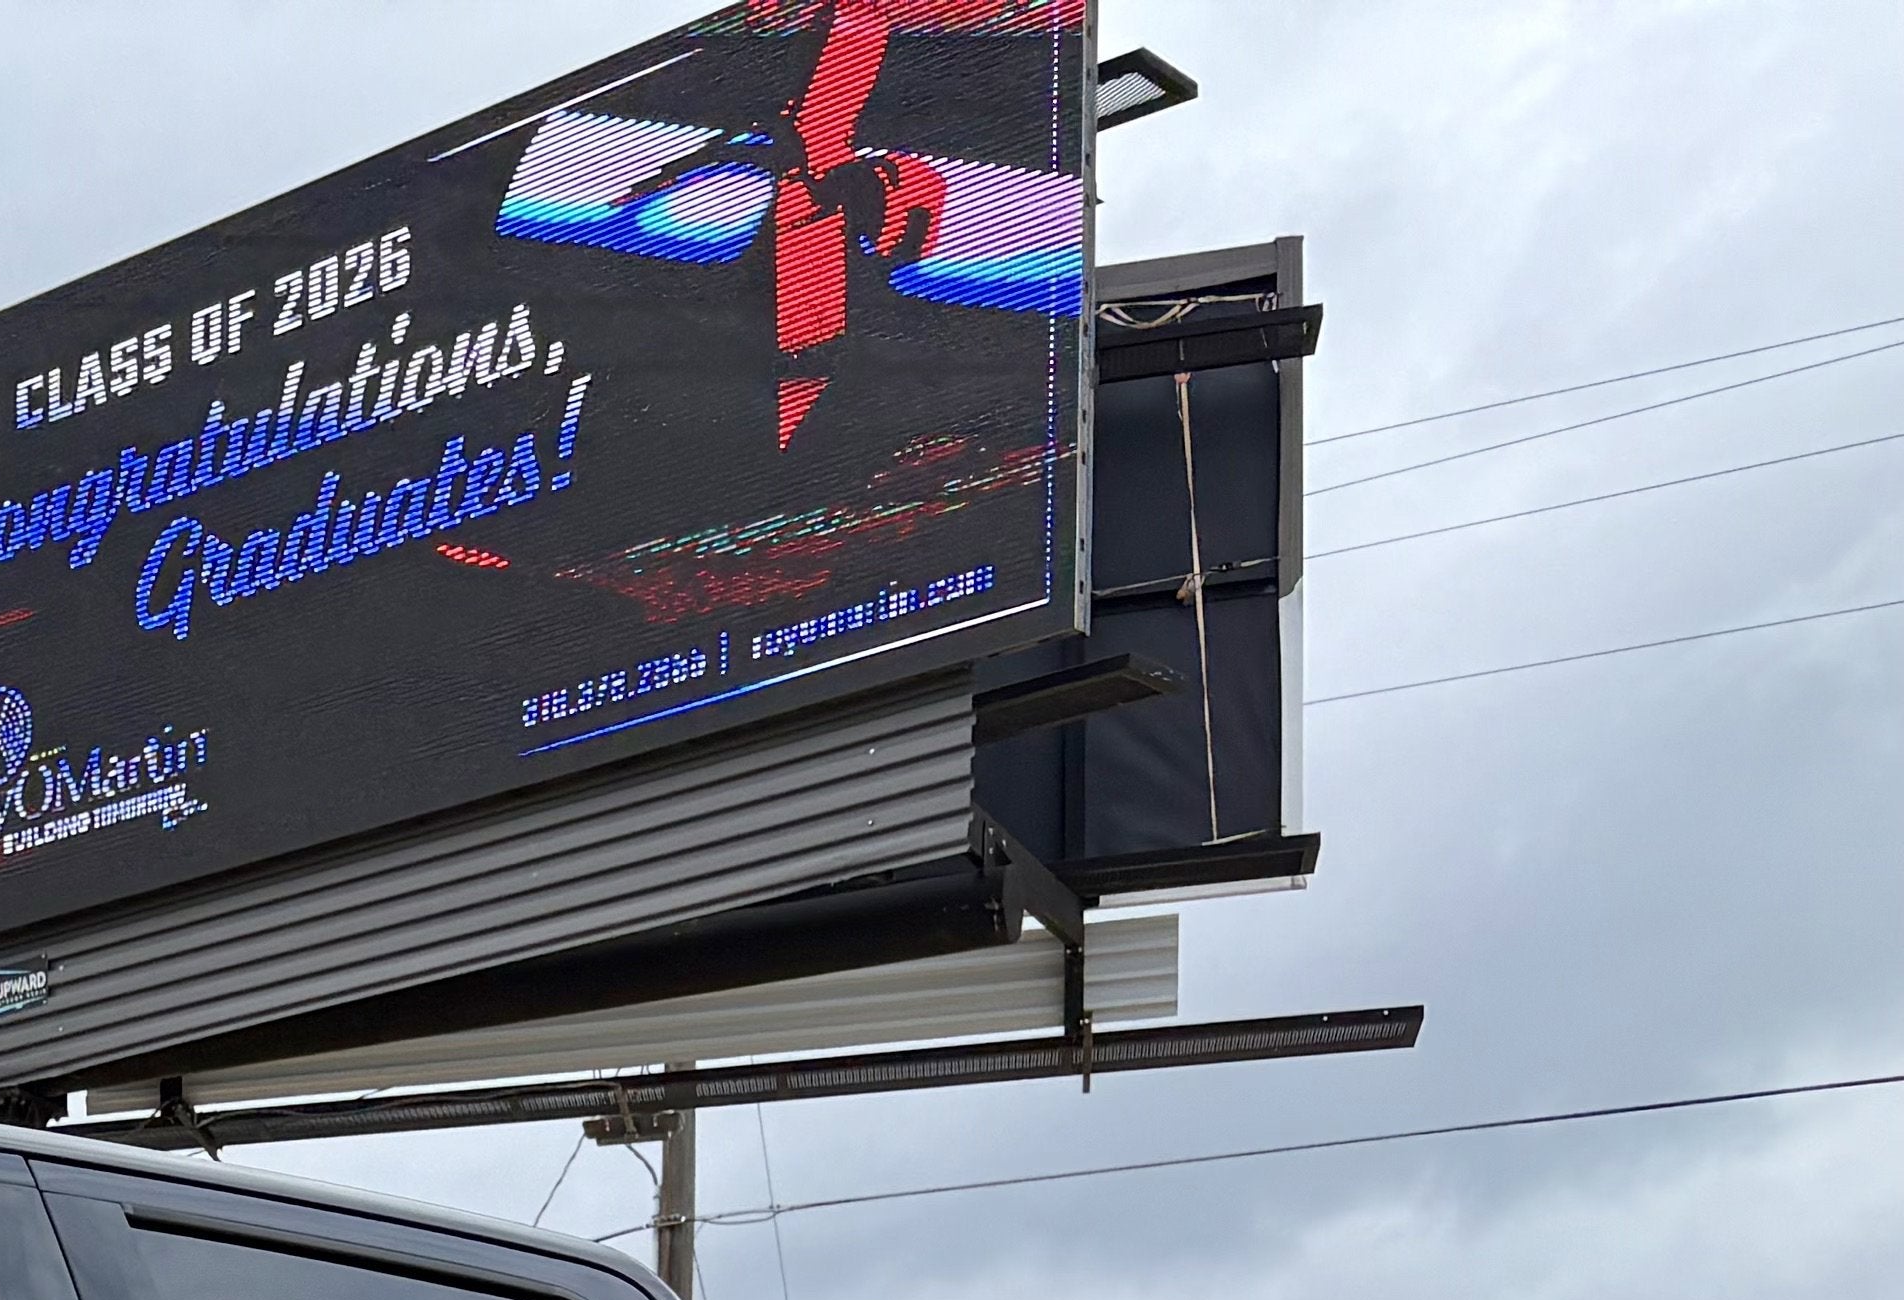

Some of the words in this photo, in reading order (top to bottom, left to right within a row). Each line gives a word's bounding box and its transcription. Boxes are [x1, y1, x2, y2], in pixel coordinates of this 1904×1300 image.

[16, 324, 172, 430] CLASS
[192, 289, 255, 365] OF
[273, 226, 412, 336] 2026
[135, 375, 591, 638] Graduates!
